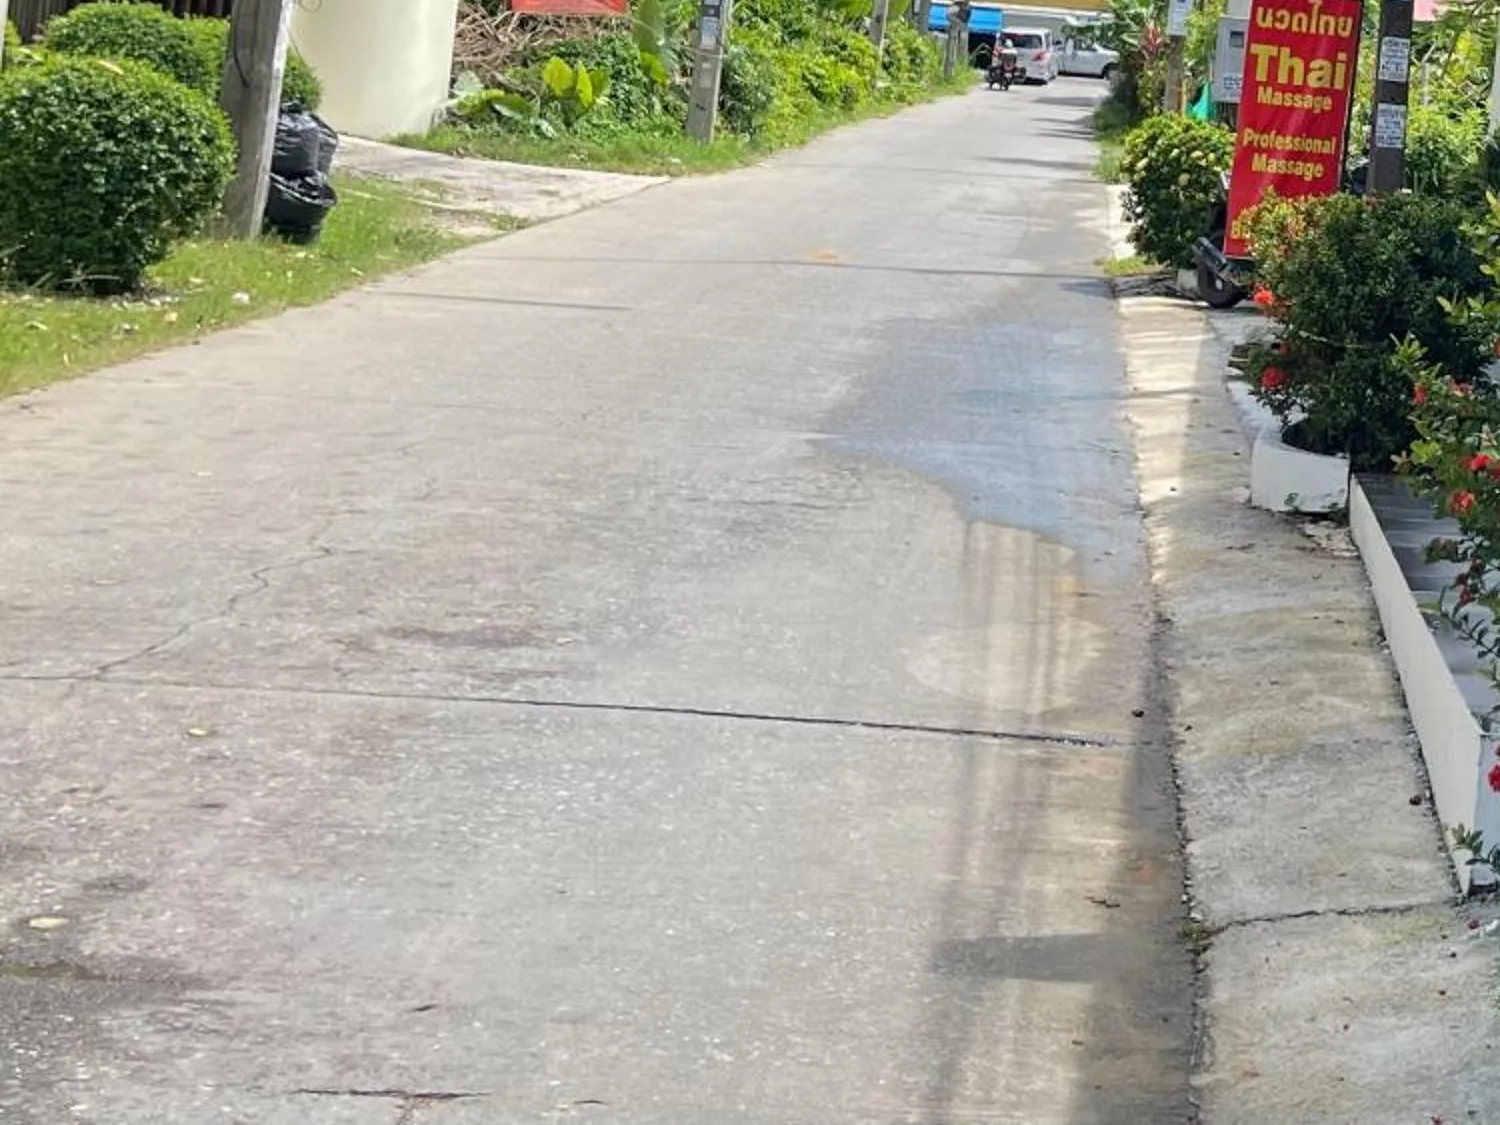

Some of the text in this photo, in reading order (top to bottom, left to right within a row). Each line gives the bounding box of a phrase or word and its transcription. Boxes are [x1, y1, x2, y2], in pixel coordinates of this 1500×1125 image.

[1250, 43, 1348, 90] Thai
[1257, 86, 1333, 114] Massage
[1243, 128, 1337, 155] Professional
[1251, 153, 1324, 181] Massage
